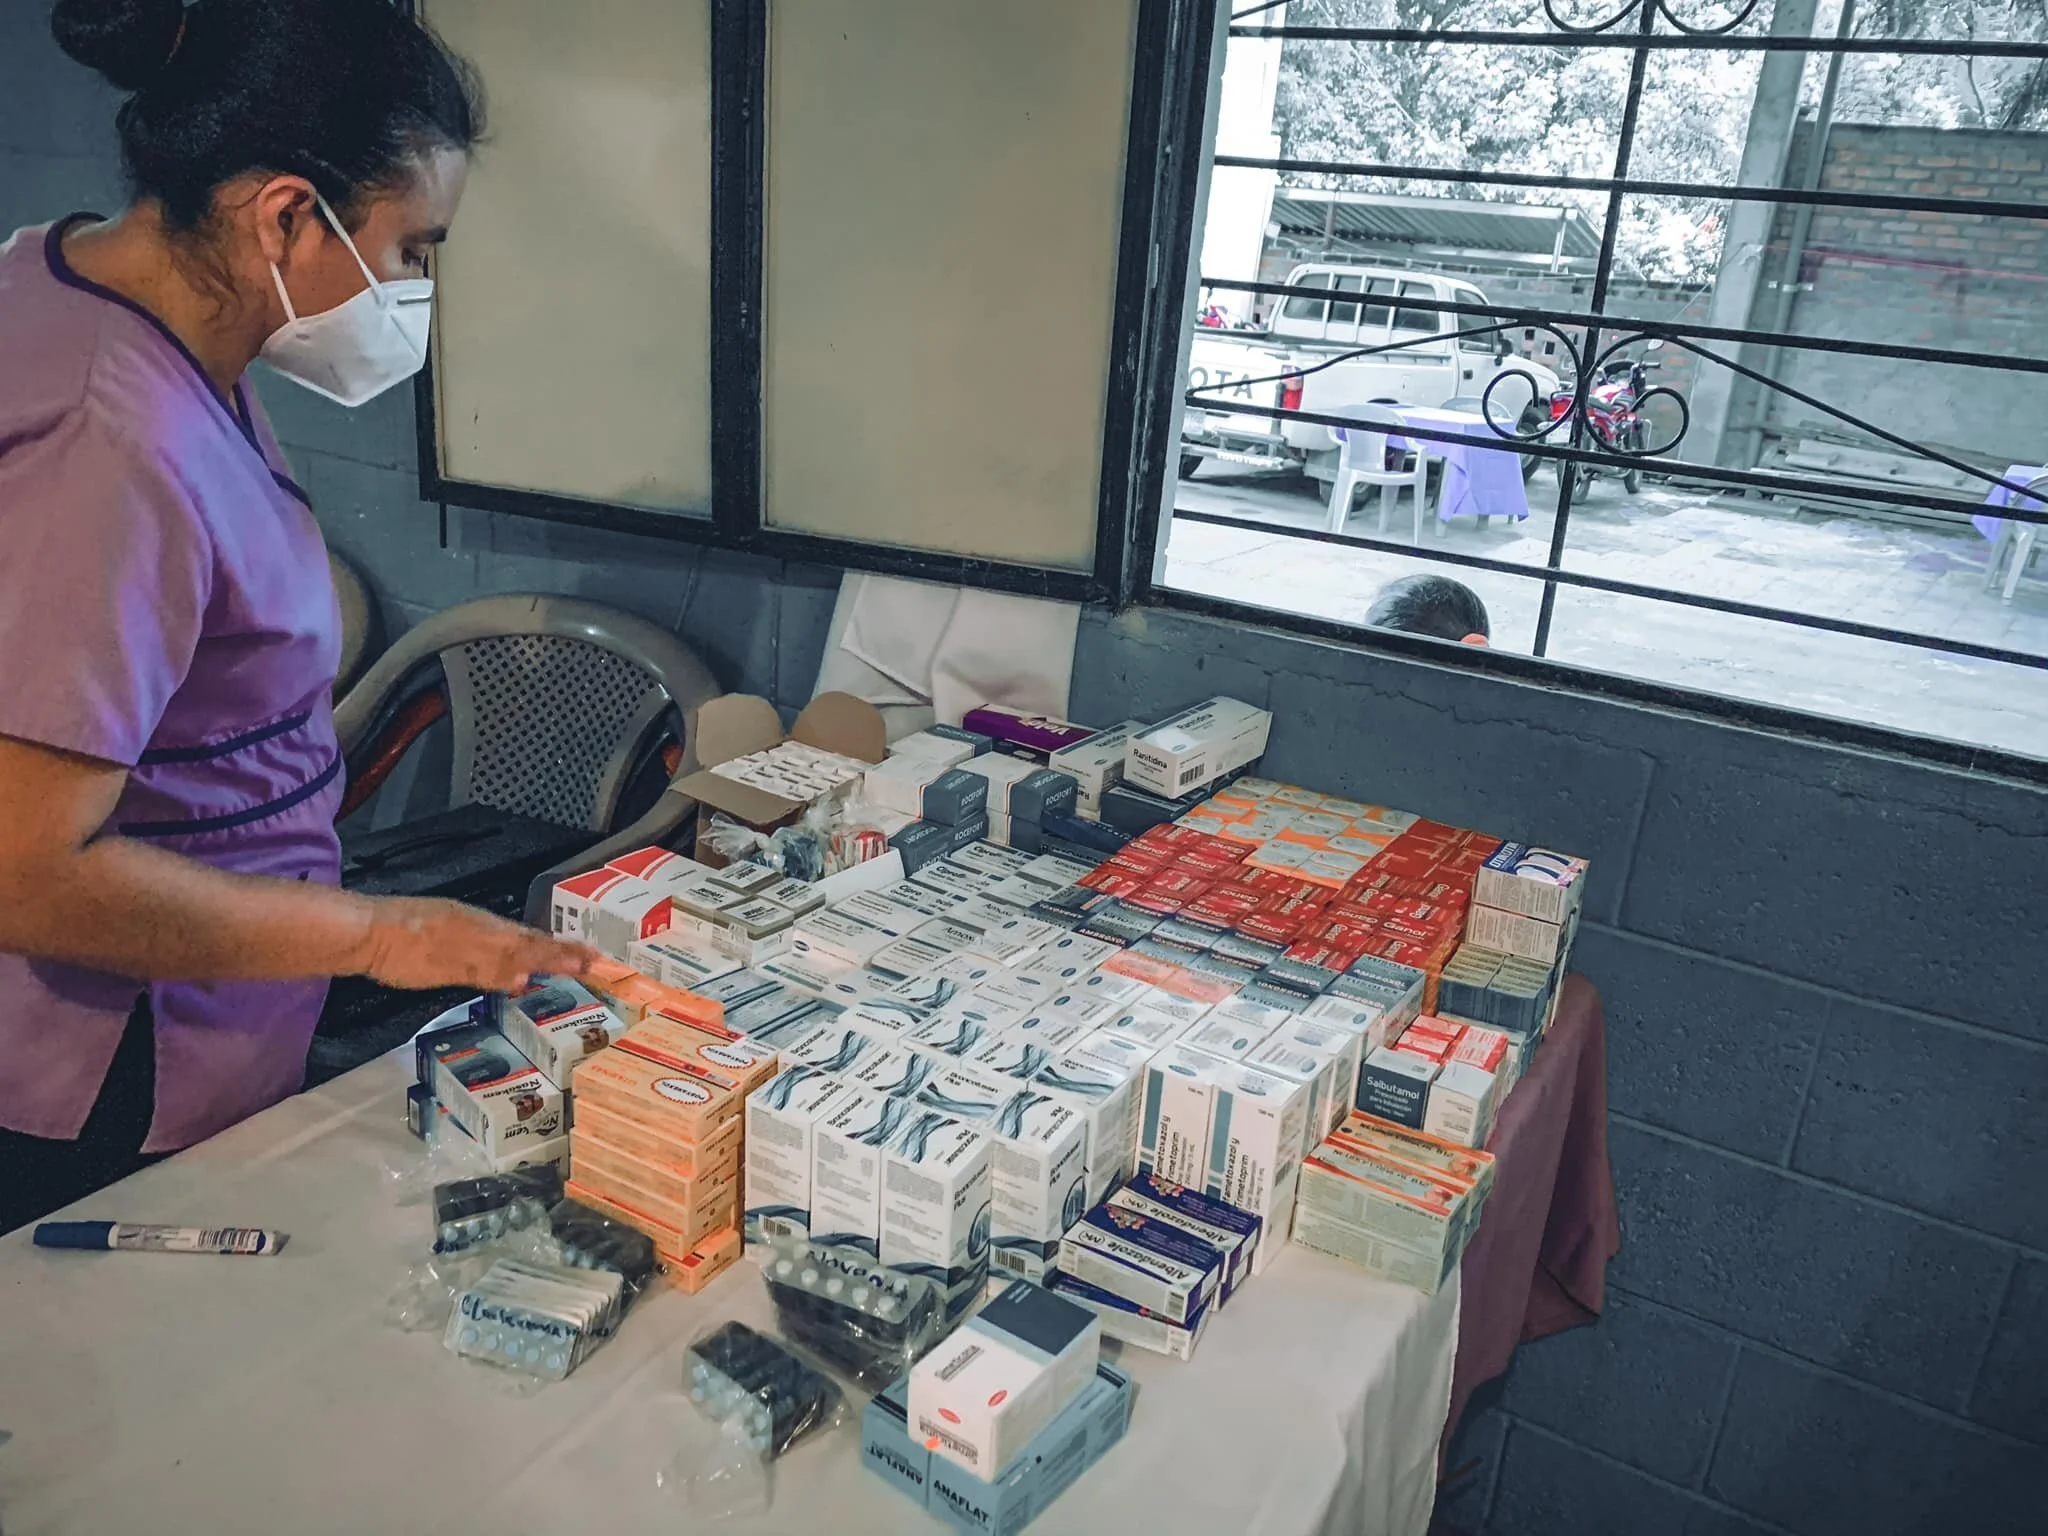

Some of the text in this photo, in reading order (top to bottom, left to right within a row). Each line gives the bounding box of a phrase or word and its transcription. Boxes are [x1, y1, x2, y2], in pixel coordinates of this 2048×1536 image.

[1190, 367, 1252, 399] OTA
[1133, 748, 1167, 769] Ranitidina
[1079, 928, 1126, 946] AMBROXOL
[1367, 1076, 1420, 1099] Salbutamol
[1223, 1146, 1238, 1201] fametoxazol
[1150, 1206, 1229, 1242] Albendazole
[1108, 1241, 1190, 1280] Albendazole
[869, 1445, 923, 1486] ANAFLAT
[934, 1479, 989, 1524] ANAFLAT
